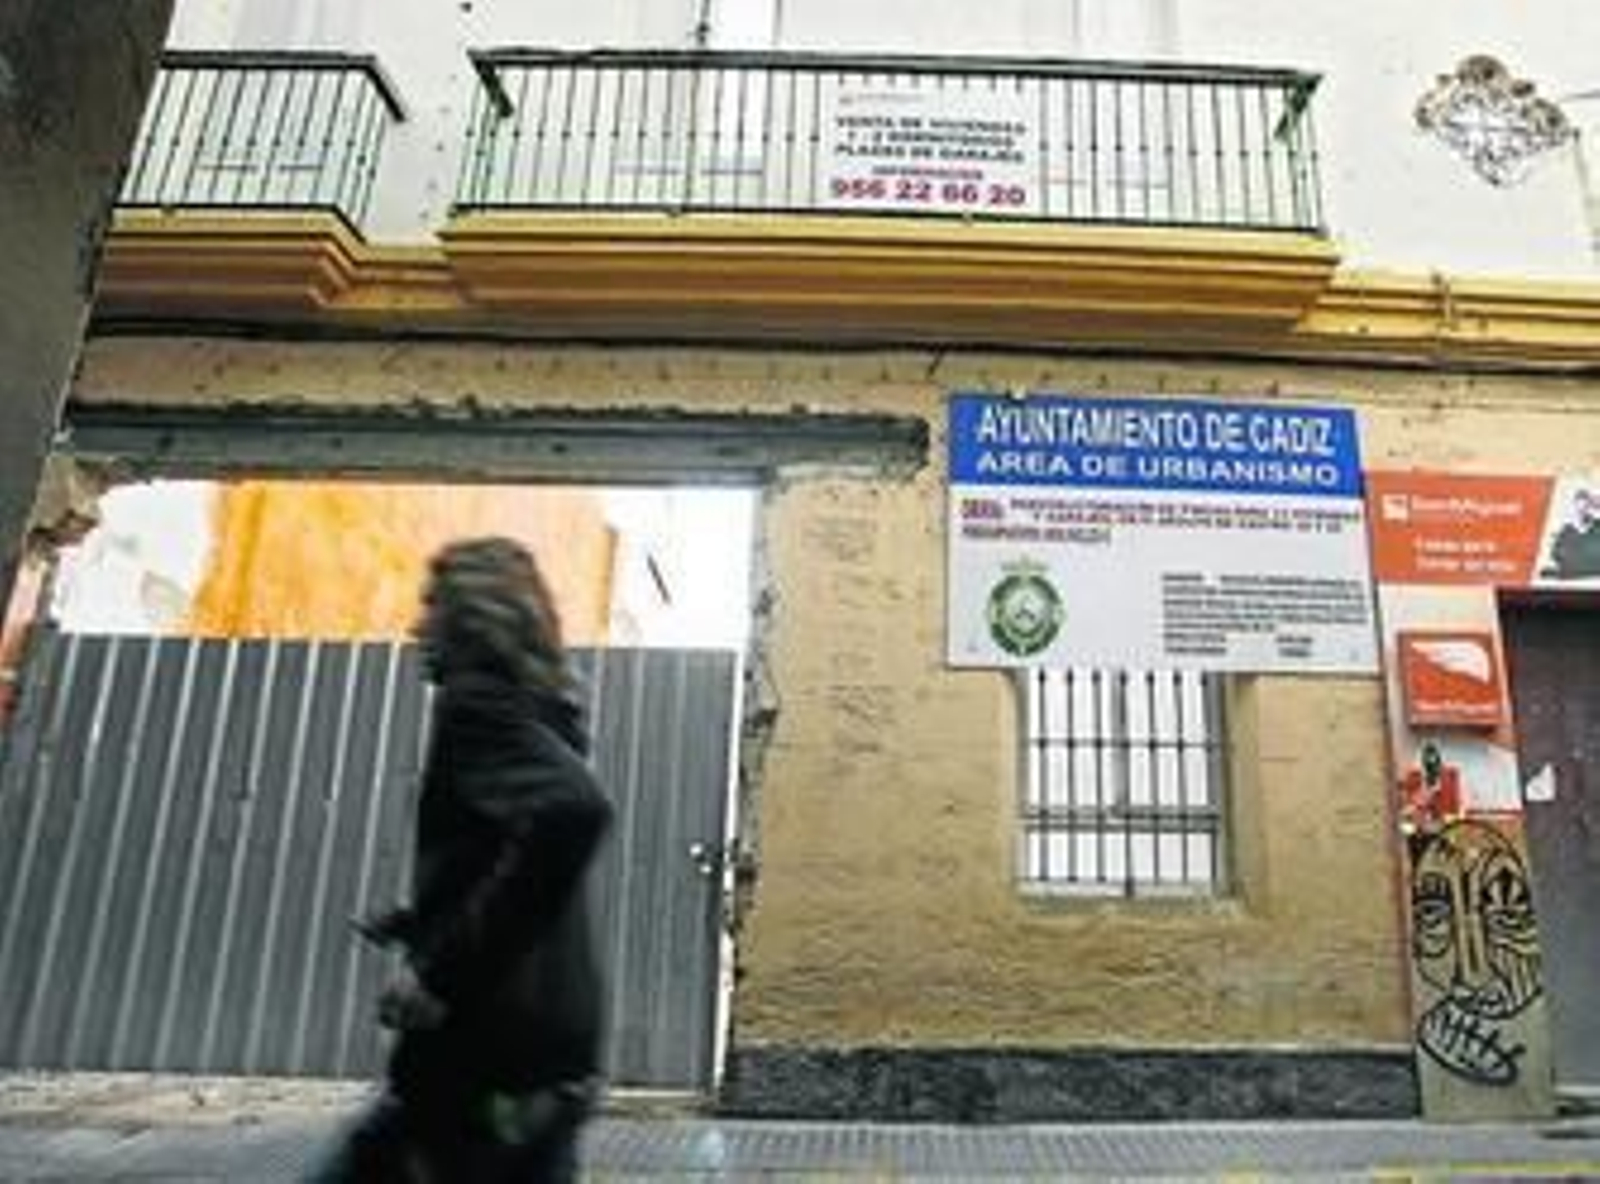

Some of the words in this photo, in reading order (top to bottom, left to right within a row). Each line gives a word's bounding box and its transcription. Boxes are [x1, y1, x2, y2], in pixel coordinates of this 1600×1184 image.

[895, 179, 931, 202] 22
[988, 185, 1026, 206] 20
[977, 404, 1199, 448] AYUNTAMIENTO
[1204, 412, 1247, 453] DE
[1250, 414, 1337, 457] CADIZ
[976, 452, 1074, 477] AREA
[1081, 455, 1127, 477] DE
[1138, 456, 1339, 486] URBANISMO
